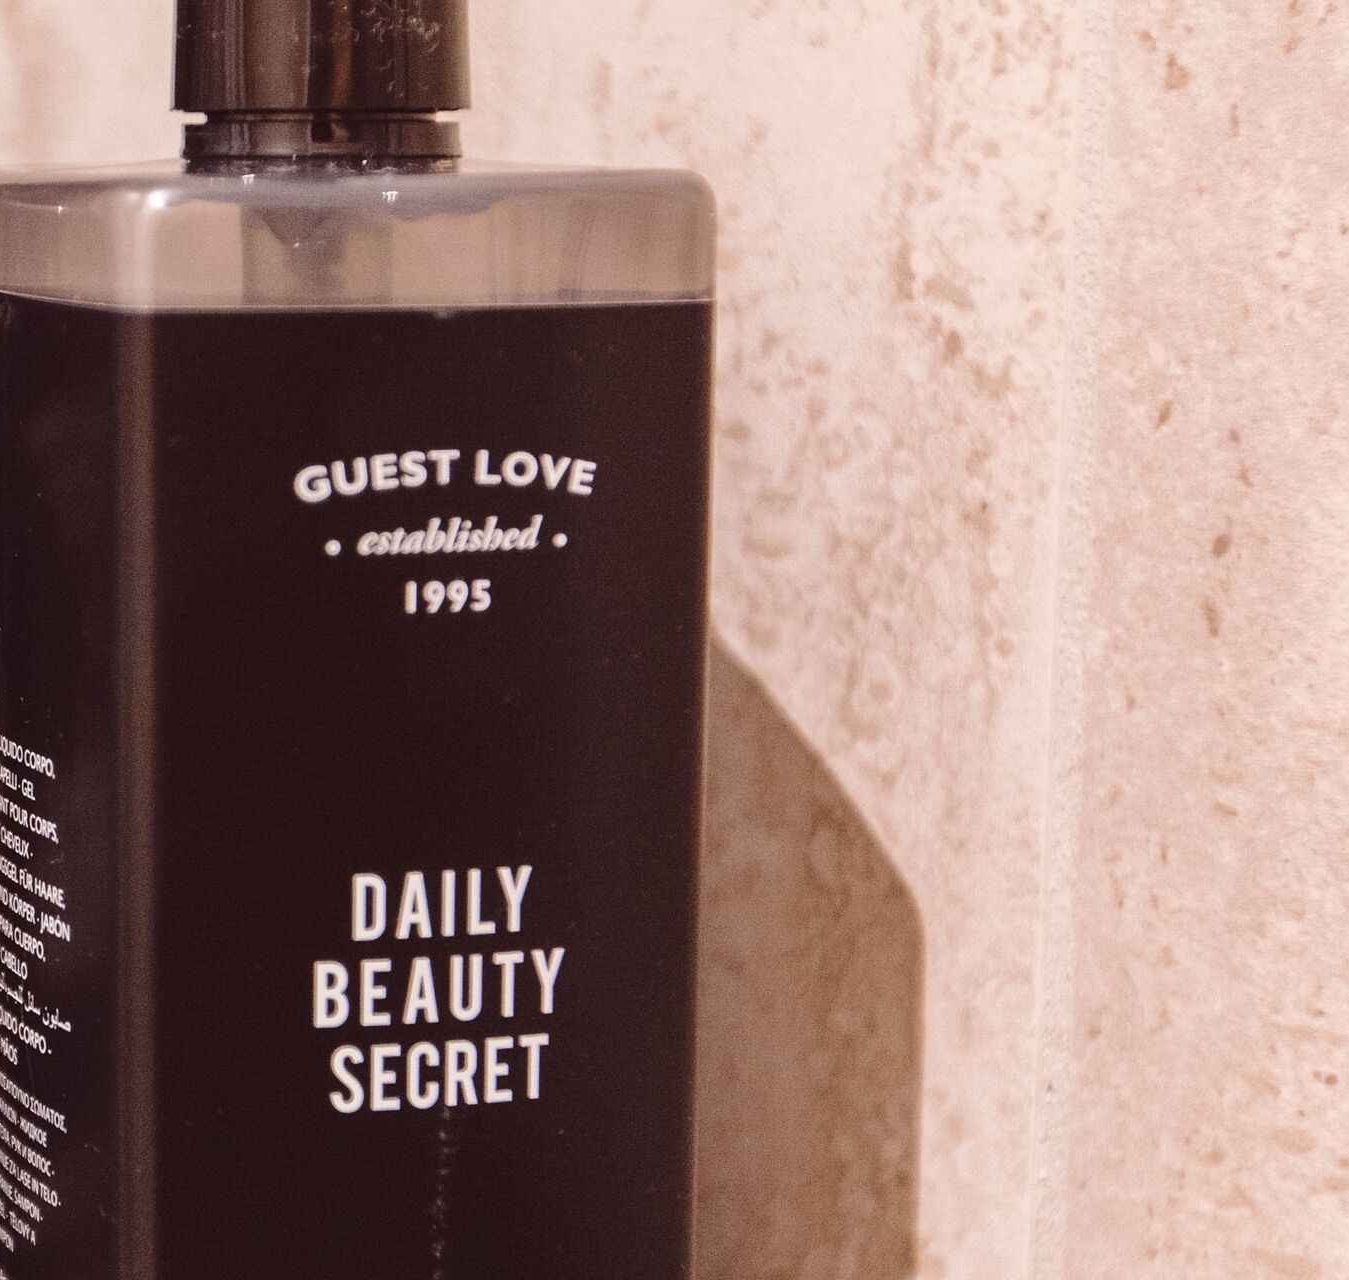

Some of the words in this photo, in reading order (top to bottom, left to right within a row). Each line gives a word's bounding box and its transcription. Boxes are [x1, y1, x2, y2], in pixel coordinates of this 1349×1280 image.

[293, 448, 460, 503] GUEST
[473, 449, 597, 496] LOVE
[356, 515, 541, 556] established
[403, 579, 492, 613] 1995
[21, 778, 35, 802] GEL
[9, 802, 28, 829] POUR
[1, 826, 29, 860] CHEVEUX
[19, 868, 32, 893] FÜR
[8, 893, 35, 925] KÖRPER
[39, 912, 70, 943] JABÓN
[350, 864, 533, 941] DAILY
[0, 947, 27, 981] CABELLO
[312, 947, 566, 1029] BEAUTY
[18, 1022, 46, 1055] CORPO
[328, 1033, 551, 1114] SECRET
[40, 1182, 57, 1208] TELO
